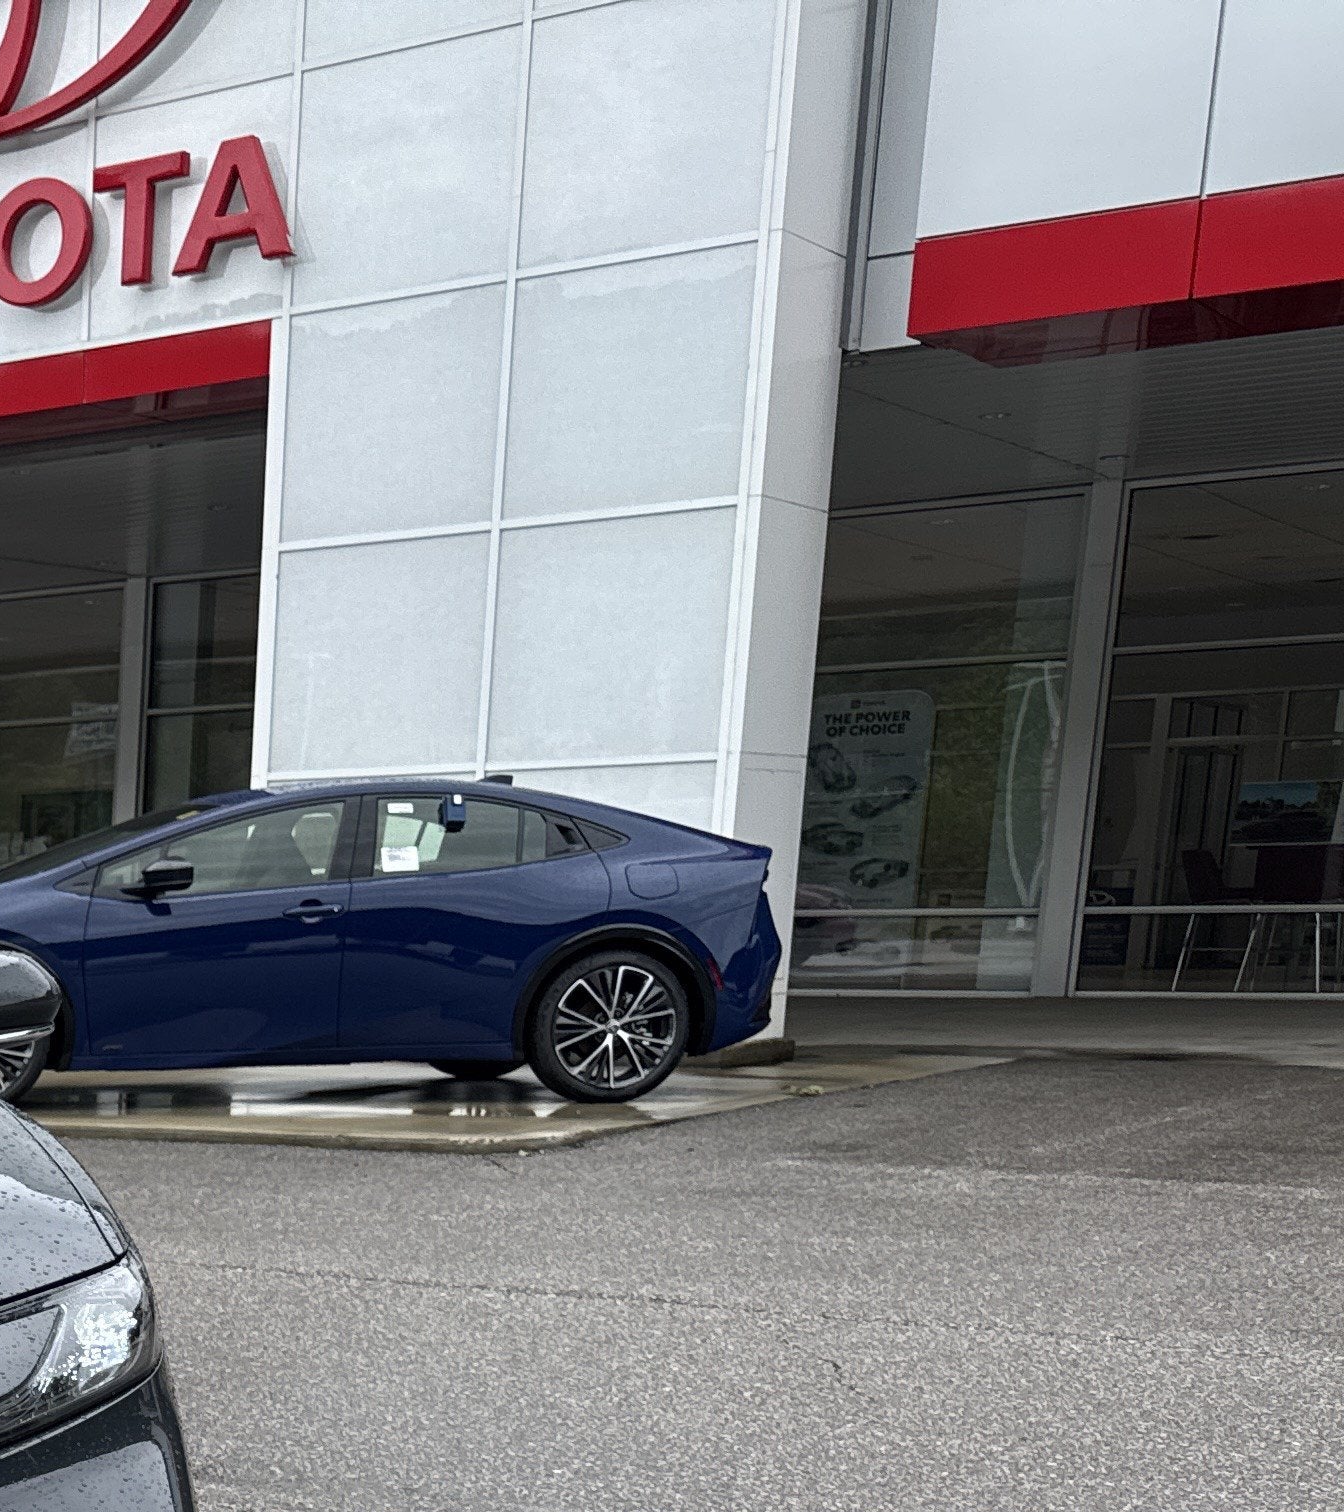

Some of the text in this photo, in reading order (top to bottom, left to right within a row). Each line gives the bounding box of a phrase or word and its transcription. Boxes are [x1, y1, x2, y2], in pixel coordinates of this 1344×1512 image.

[824, 710, 912, 725] THE POWER
[826, 723, 906, 737] OF CHOICE
